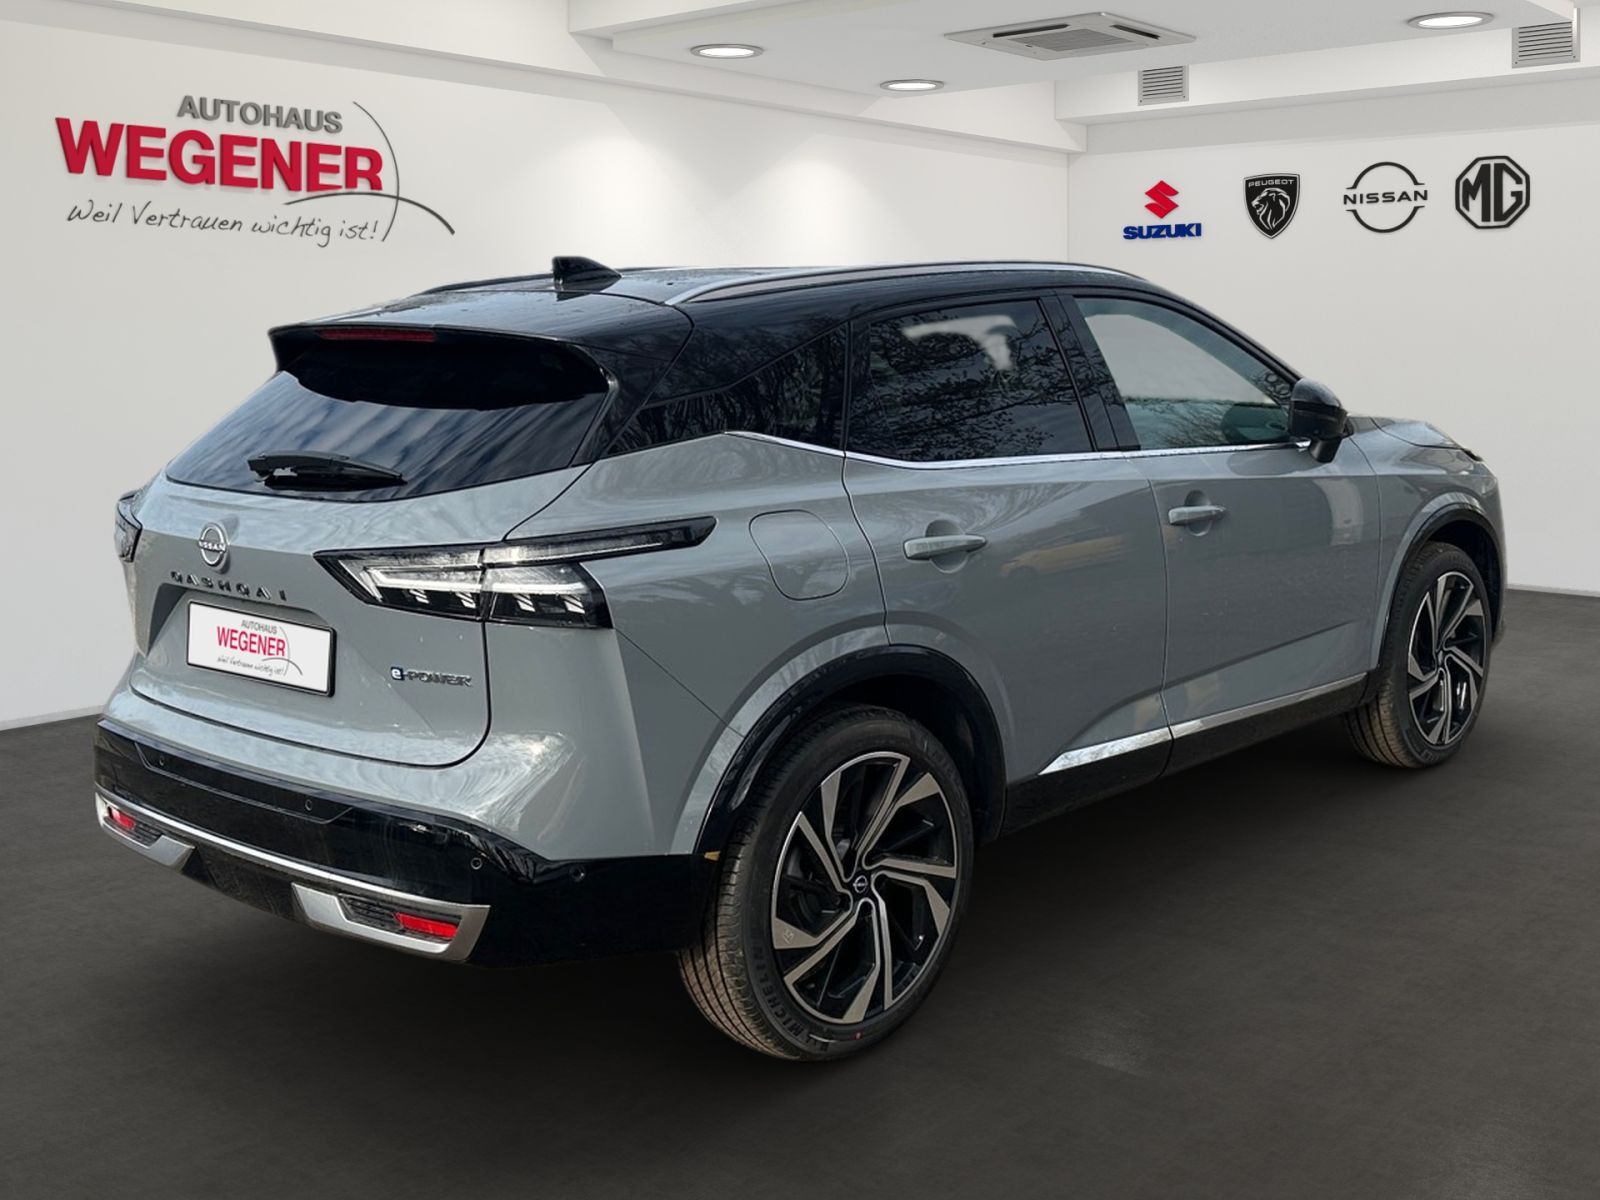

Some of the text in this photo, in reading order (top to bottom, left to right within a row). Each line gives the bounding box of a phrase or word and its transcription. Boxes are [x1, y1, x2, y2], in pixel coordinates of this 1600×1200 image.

[177, 95, 343, 134] AUTOHAUS
[55, 116, 384, 193] WEGENER
[1248, 179, 1295, 188] PEUGEOT
[1343, 190, 1428, 206] NISSAN
[1462, 162, 1524, 223] MG
[66, 199, 379, 248] Weil Vertrauen wichtig ist!
[1123, 222, 1202, 240] SUZUKI
[170, 570, 287, 602] QASHQAI
[216, 625, 286, 657] WEGENER
[241, 619, 278, 635] AUTOHAUS
